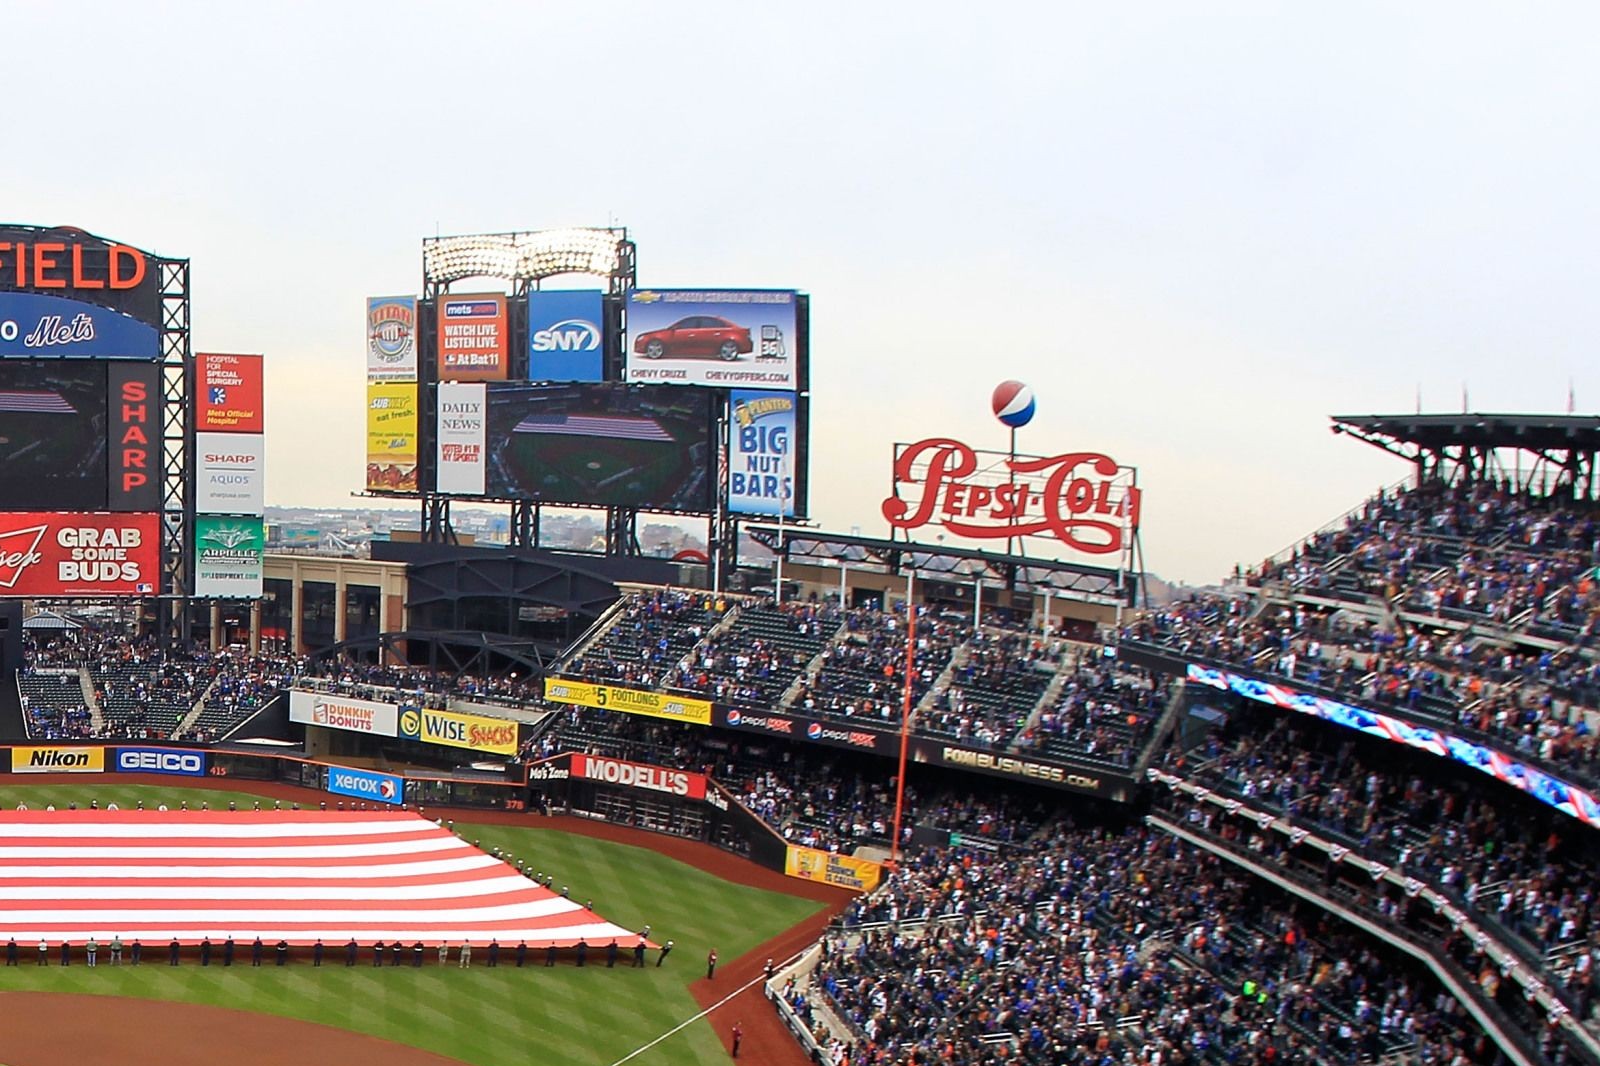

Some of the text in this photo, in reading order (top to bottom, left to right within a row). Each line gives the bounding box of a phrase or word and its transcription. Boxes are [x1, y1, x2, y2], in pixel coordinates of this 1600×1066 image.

[24, 313, 95, 348] Mets
[445, 324, 498, 336] WATCH LIVE.
[445, 337, 498, 349] LISTEN LIVE.
[532, 330, 590, 351] SNY
[207, 356, 239, 364] HOSPITAL
[457, 353, 498, 366] At Bat 11
[207, 370, 238, 378] SPECIAL
[631, 369, 687, 379] CHEVY CRUZE
[705, 370, 789, 382] CHEVYOFFERS.COM
[207, 377, 243, 386] SURGERY
[442, 403, 480, 413] DAILY
[748, 398, 792, 414] PLANTERS
[207, 409, 253, 418] Mets Official
[376, 413, 389, 422] eat
[207, 417, 238, 426] Hospital
[442, 420, 481, 429] NEWS
[122, 382, 147, 492] SHARP
[739, 426, 787, 454] BIG
[441, 444, 462, 453] VOTED
[205, 455, 255, 463] SHARP
[442, 453, 479, 462] NY SPORTS
[747, 456, 780, 473] NUT
[210, 475, 249, 484] AQUOS
[732, 472, 792, 499] BARS
[57, 527, 141, 549] GRAB
[71, 548, 127, 561] SOME
[58, 561, 140, 582] BUDS
[549, 685, 591, 699] SUBWAY
[611, 689, 660, 706] FOOTLONGS
[329, 704, 374, 718] DUNKIN'
[663, 702, 708, 719] SUBWAY
[329, 715, 372, 731] DONUTS
[741, 715, 766, 727] pepsi
[424, 714, 515, 747] WISE SNACKS
[822, 729, 848, 741] pepsi
[30, 750, 89, 767] Nikon
[120, 751, 201, 772] GEICO
[210, 766, 226, 776] 415
[585, 757, 689, 796] MODELL'S
[335, 773, 377, 794] xerox
